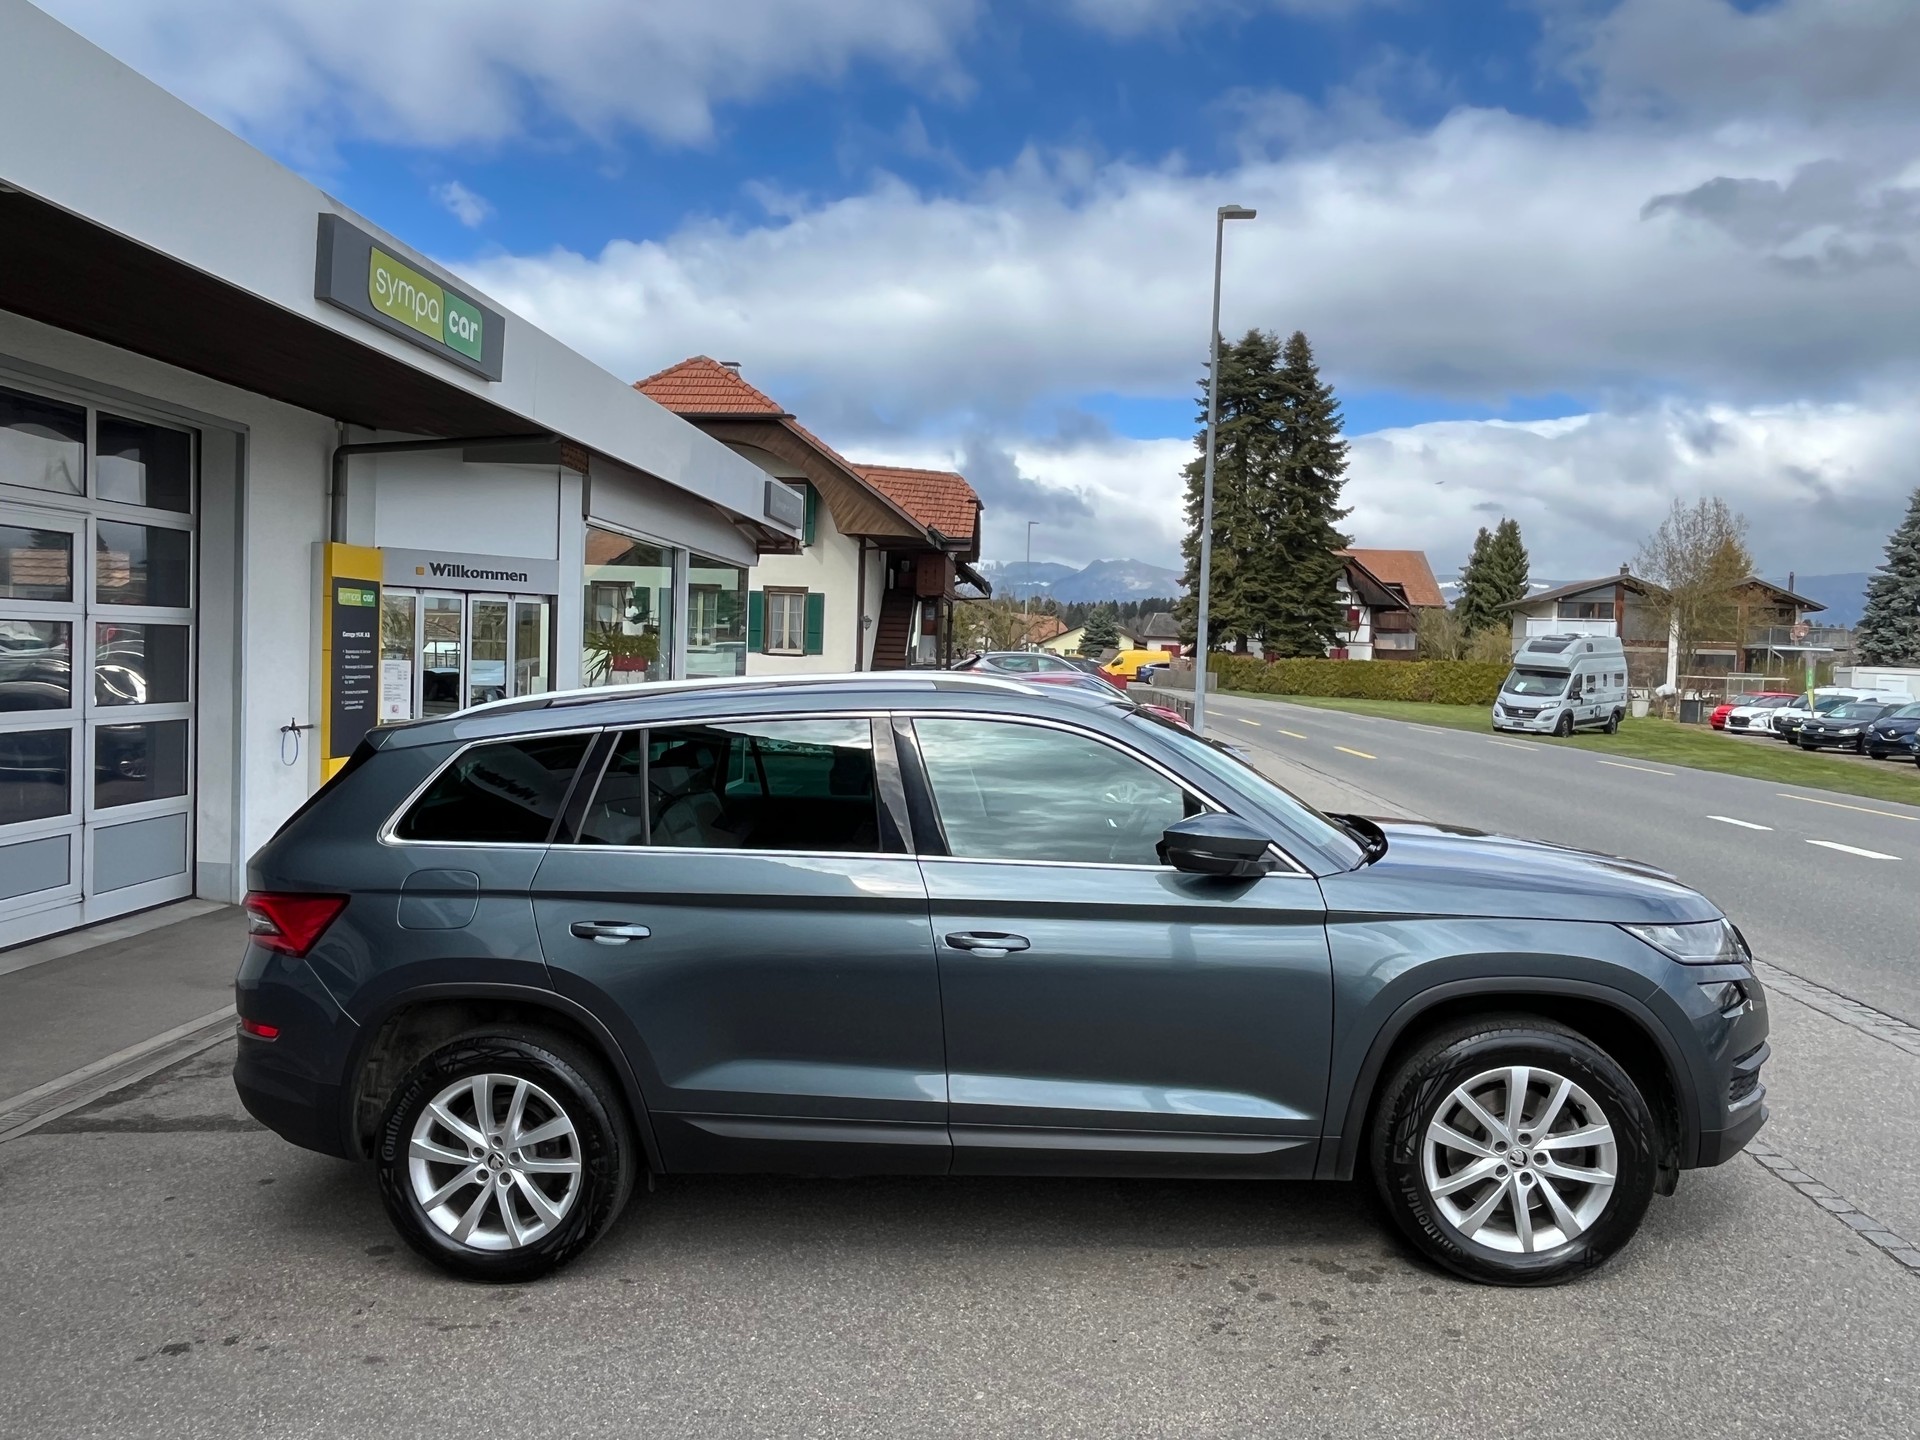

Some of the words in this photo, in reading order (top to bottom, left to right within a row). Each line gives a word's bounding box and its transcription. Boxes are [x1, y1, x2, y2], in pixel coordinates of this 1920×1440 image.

[375, 267, 439, 324] sympa
[448, 310, 478, 343] car
[429, 562, 528, 583] Willkommen
[381, 1079, 424, 1161] Continental
